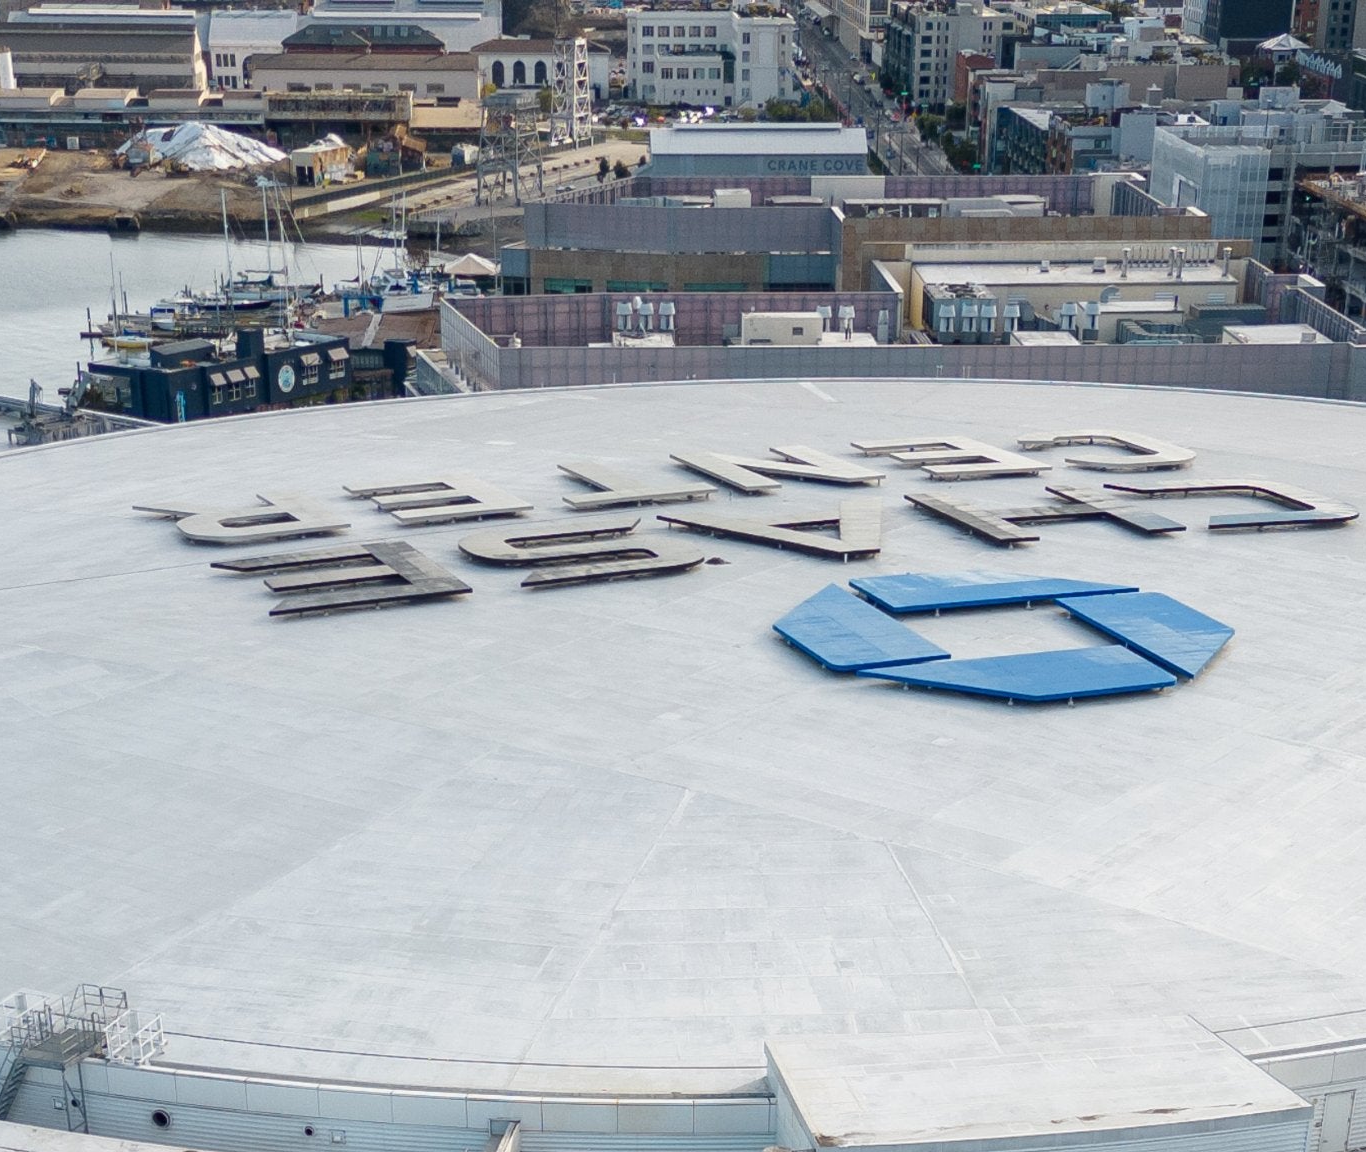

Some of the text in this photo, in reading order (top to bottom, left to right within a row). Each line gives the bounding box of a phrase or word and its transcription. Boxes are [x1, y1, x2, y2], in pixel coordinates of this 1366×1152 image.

[767, 159, 864, 171] CRANE COVE
[133, 429, 1196, 543] CENTER
[210, 479, 1360, 616] CHASE
